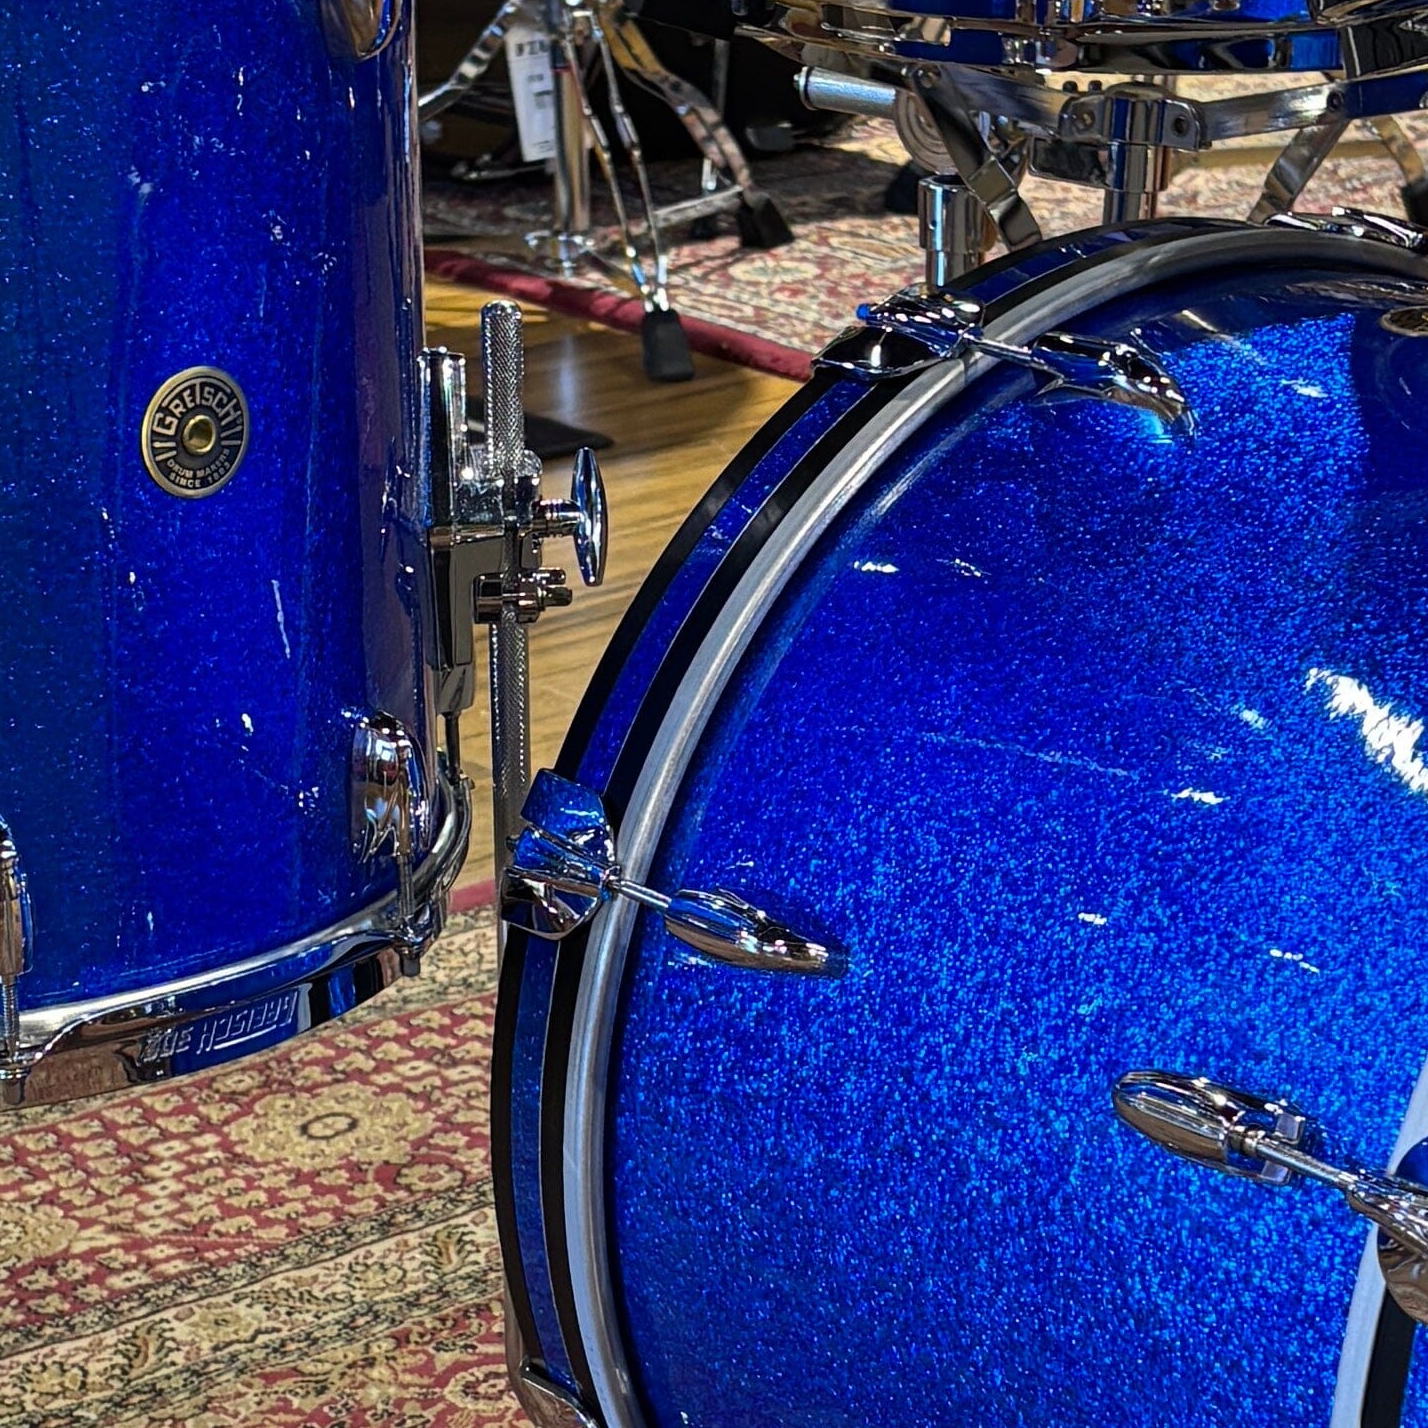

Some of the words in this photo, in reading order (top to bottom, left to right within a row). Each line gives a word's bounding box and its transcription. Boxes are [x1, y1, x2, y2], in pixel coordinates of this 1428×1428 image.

[152, 377, 243, 436] GRETSCH
[167, 458, 194, 479] DRUM
[196, 447, 230, 478] MAKERS
[169, 472, 201, 488] SINCE
